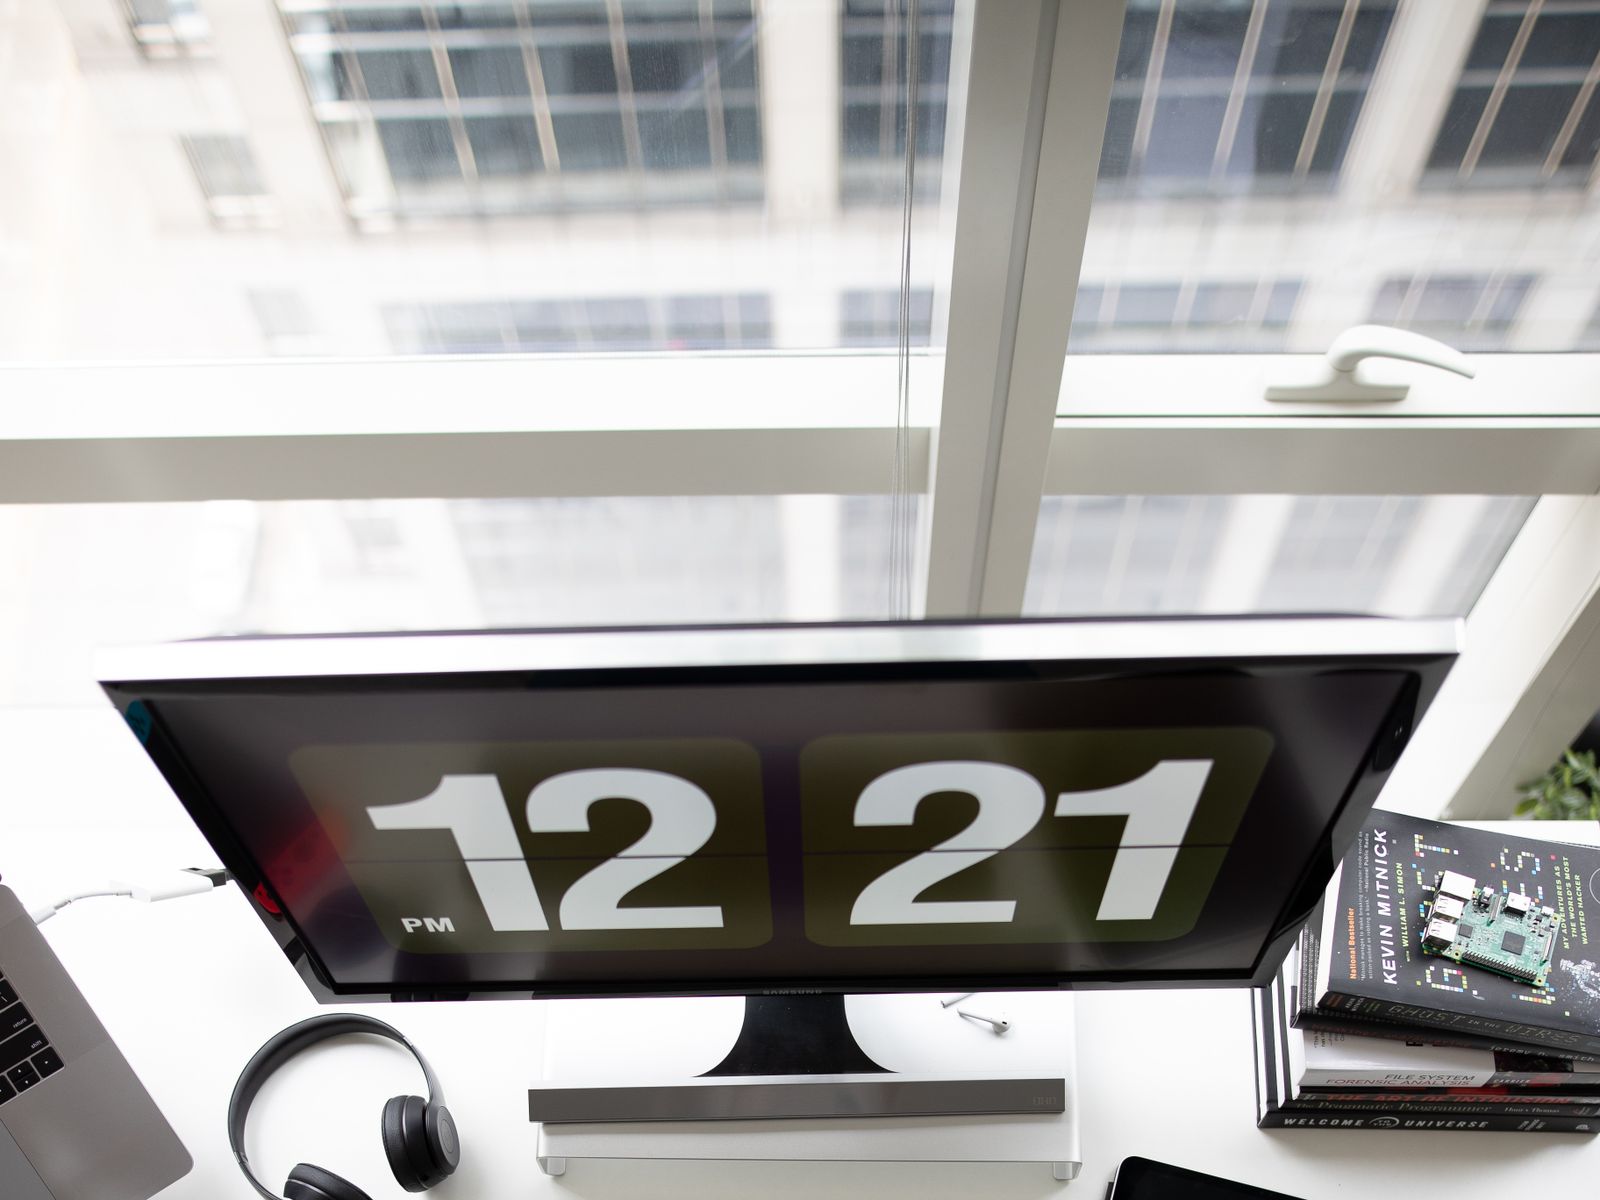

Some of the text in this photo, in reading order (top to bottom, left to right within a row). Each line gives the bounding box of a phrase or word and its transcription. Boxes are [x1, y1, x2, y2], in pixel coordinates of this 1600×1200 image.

[366, 767, 724, 931] 12
[850, 759, 1214, 925] 21
[1396, 863, 1404, 894] SIMON
[1374, 829, 1397, 984] KEVIN MITNICK
[1399, 897, 1405, 905] L.
[1554, 865, 1570, 949] MY ADVENTURES AS
[1566, 882, 1576, 919] WORLD'S
[1575, 874, 1588, 945] WANTED HACKER
[401, 916, 456, 933] PM
[1399, 908, 1409, 947] WILLIAM
[1347, 907, 1357, 979] National Bestseller
[12, 1017, 28, 1029] return
[1387, 1005, 1466, 1023] GHOST
[30, 1040, 42, 1049] shift
[1283, 1118, 1365, 1127] WELCOME
[1404, 1120, 1489, 1128] UNIVERSE
